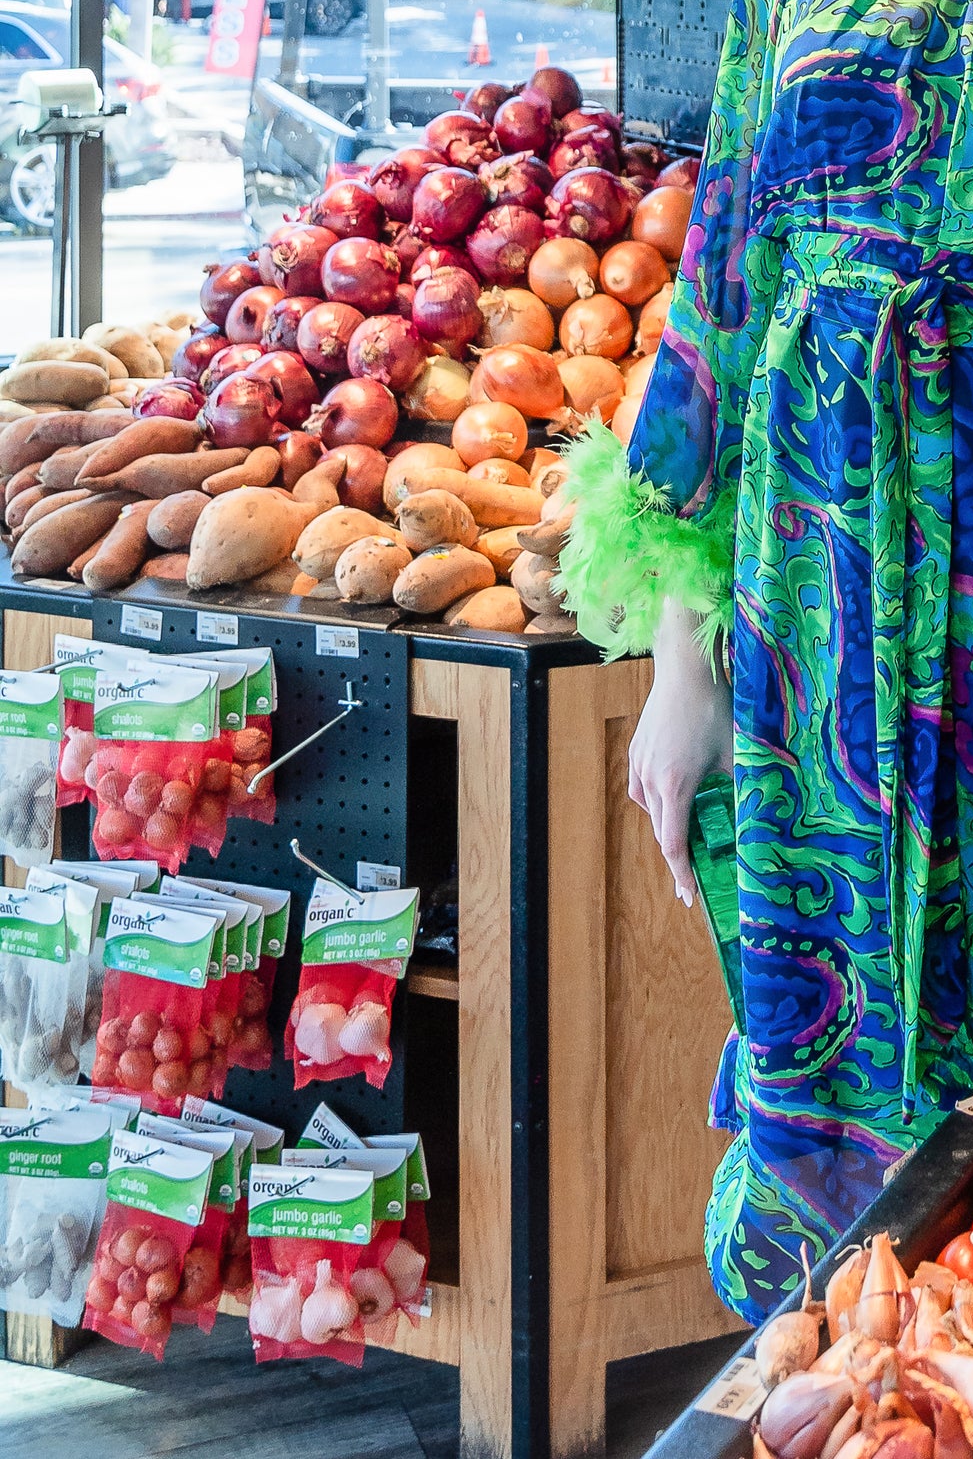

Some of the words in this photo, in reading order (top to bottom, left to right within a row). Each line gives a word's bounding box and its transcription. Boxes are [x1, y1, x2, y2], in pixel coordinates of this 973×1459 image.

[112, 713, 143, 726] shallots
[324, 932, 357, 949] jumbo
[359, 929, 387, 946] garlic
[120, 943, 150, 960] shallots
[9, 1149, 39, 1164] ginger
[41, 1153, 62, 1165] root
[272, 1206, 308, 1224] jumbo
[311, 1208, 342, 1226] garlic
